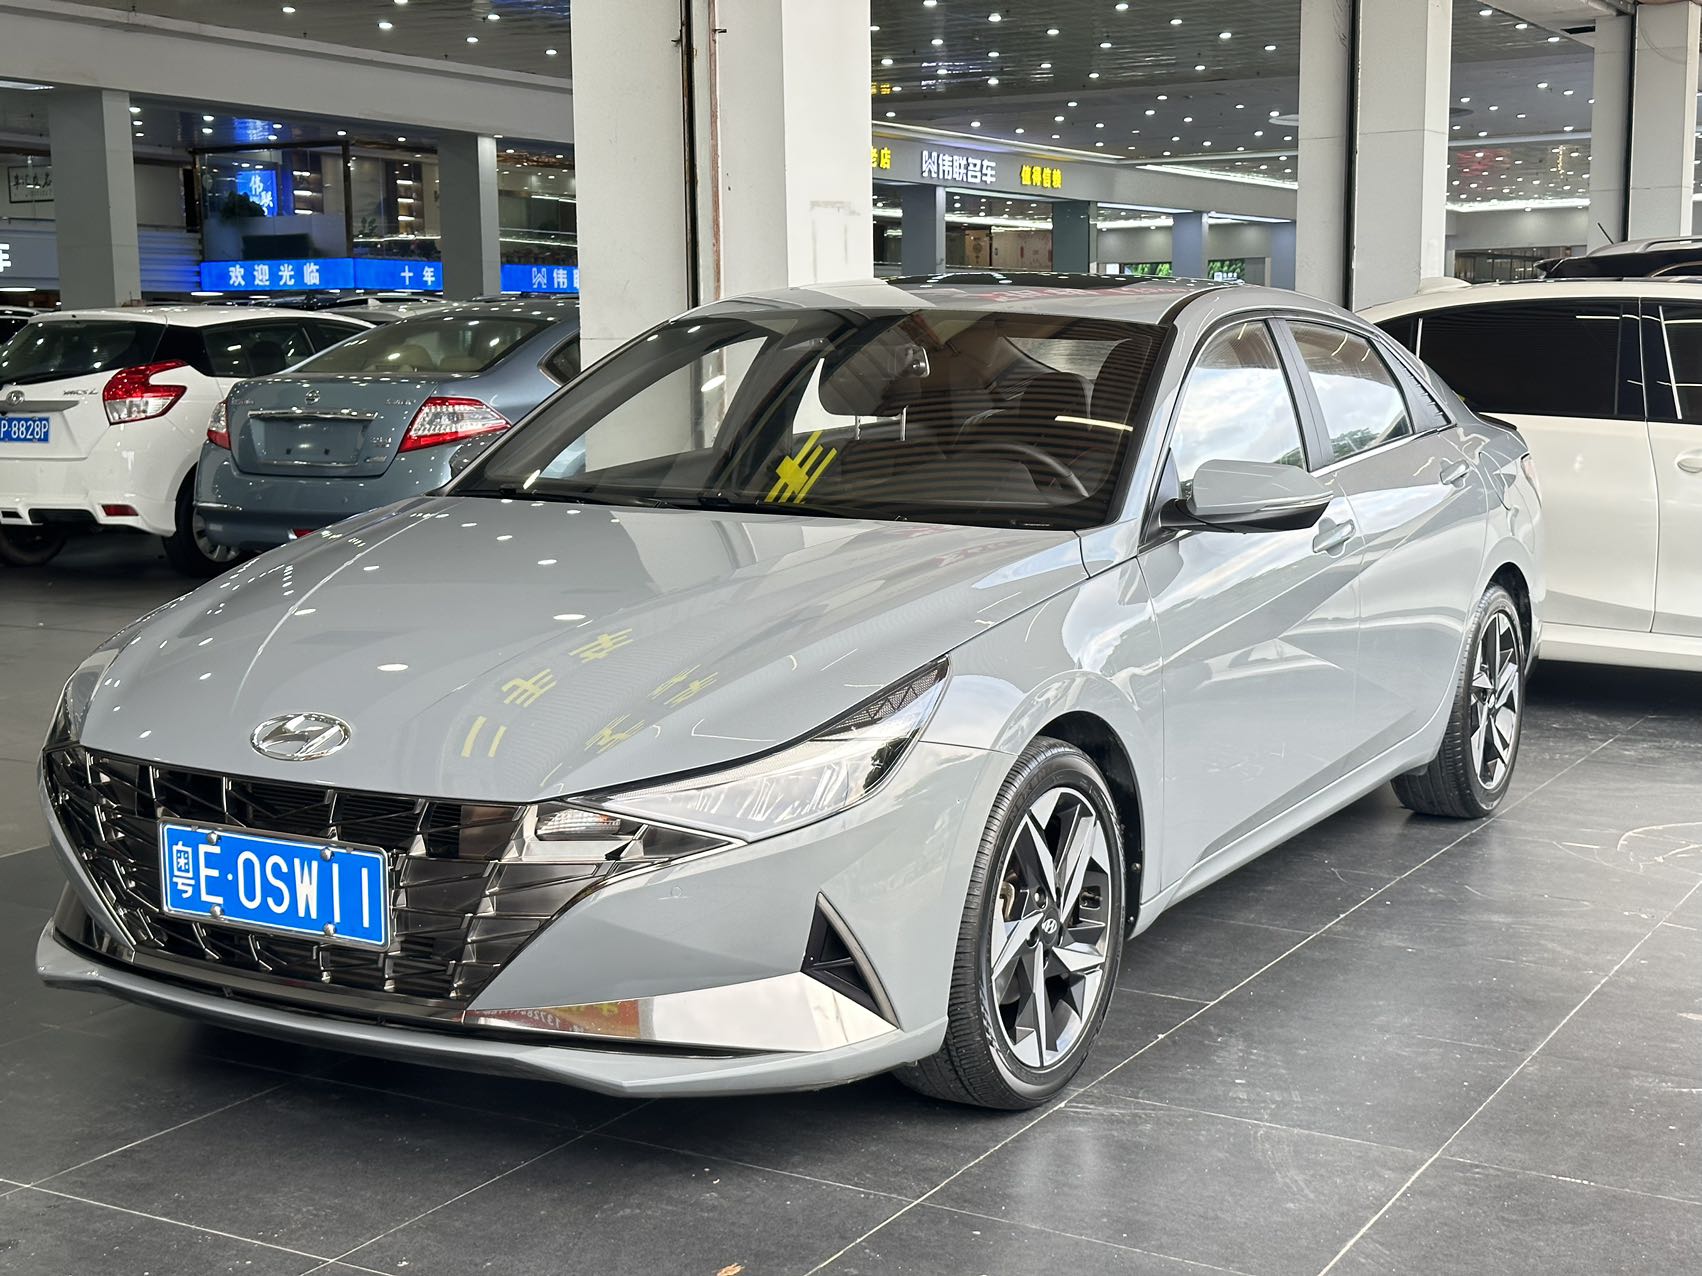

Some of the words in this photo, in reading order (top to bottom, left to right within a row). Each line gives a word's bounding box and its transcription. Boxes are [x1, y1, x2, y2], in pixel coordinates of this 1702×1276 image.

[938, 153, 996, 184] 伟联名车
[229, 263, 320, 286] 欢迎光临
[400, 265, 436, 285] 十年
